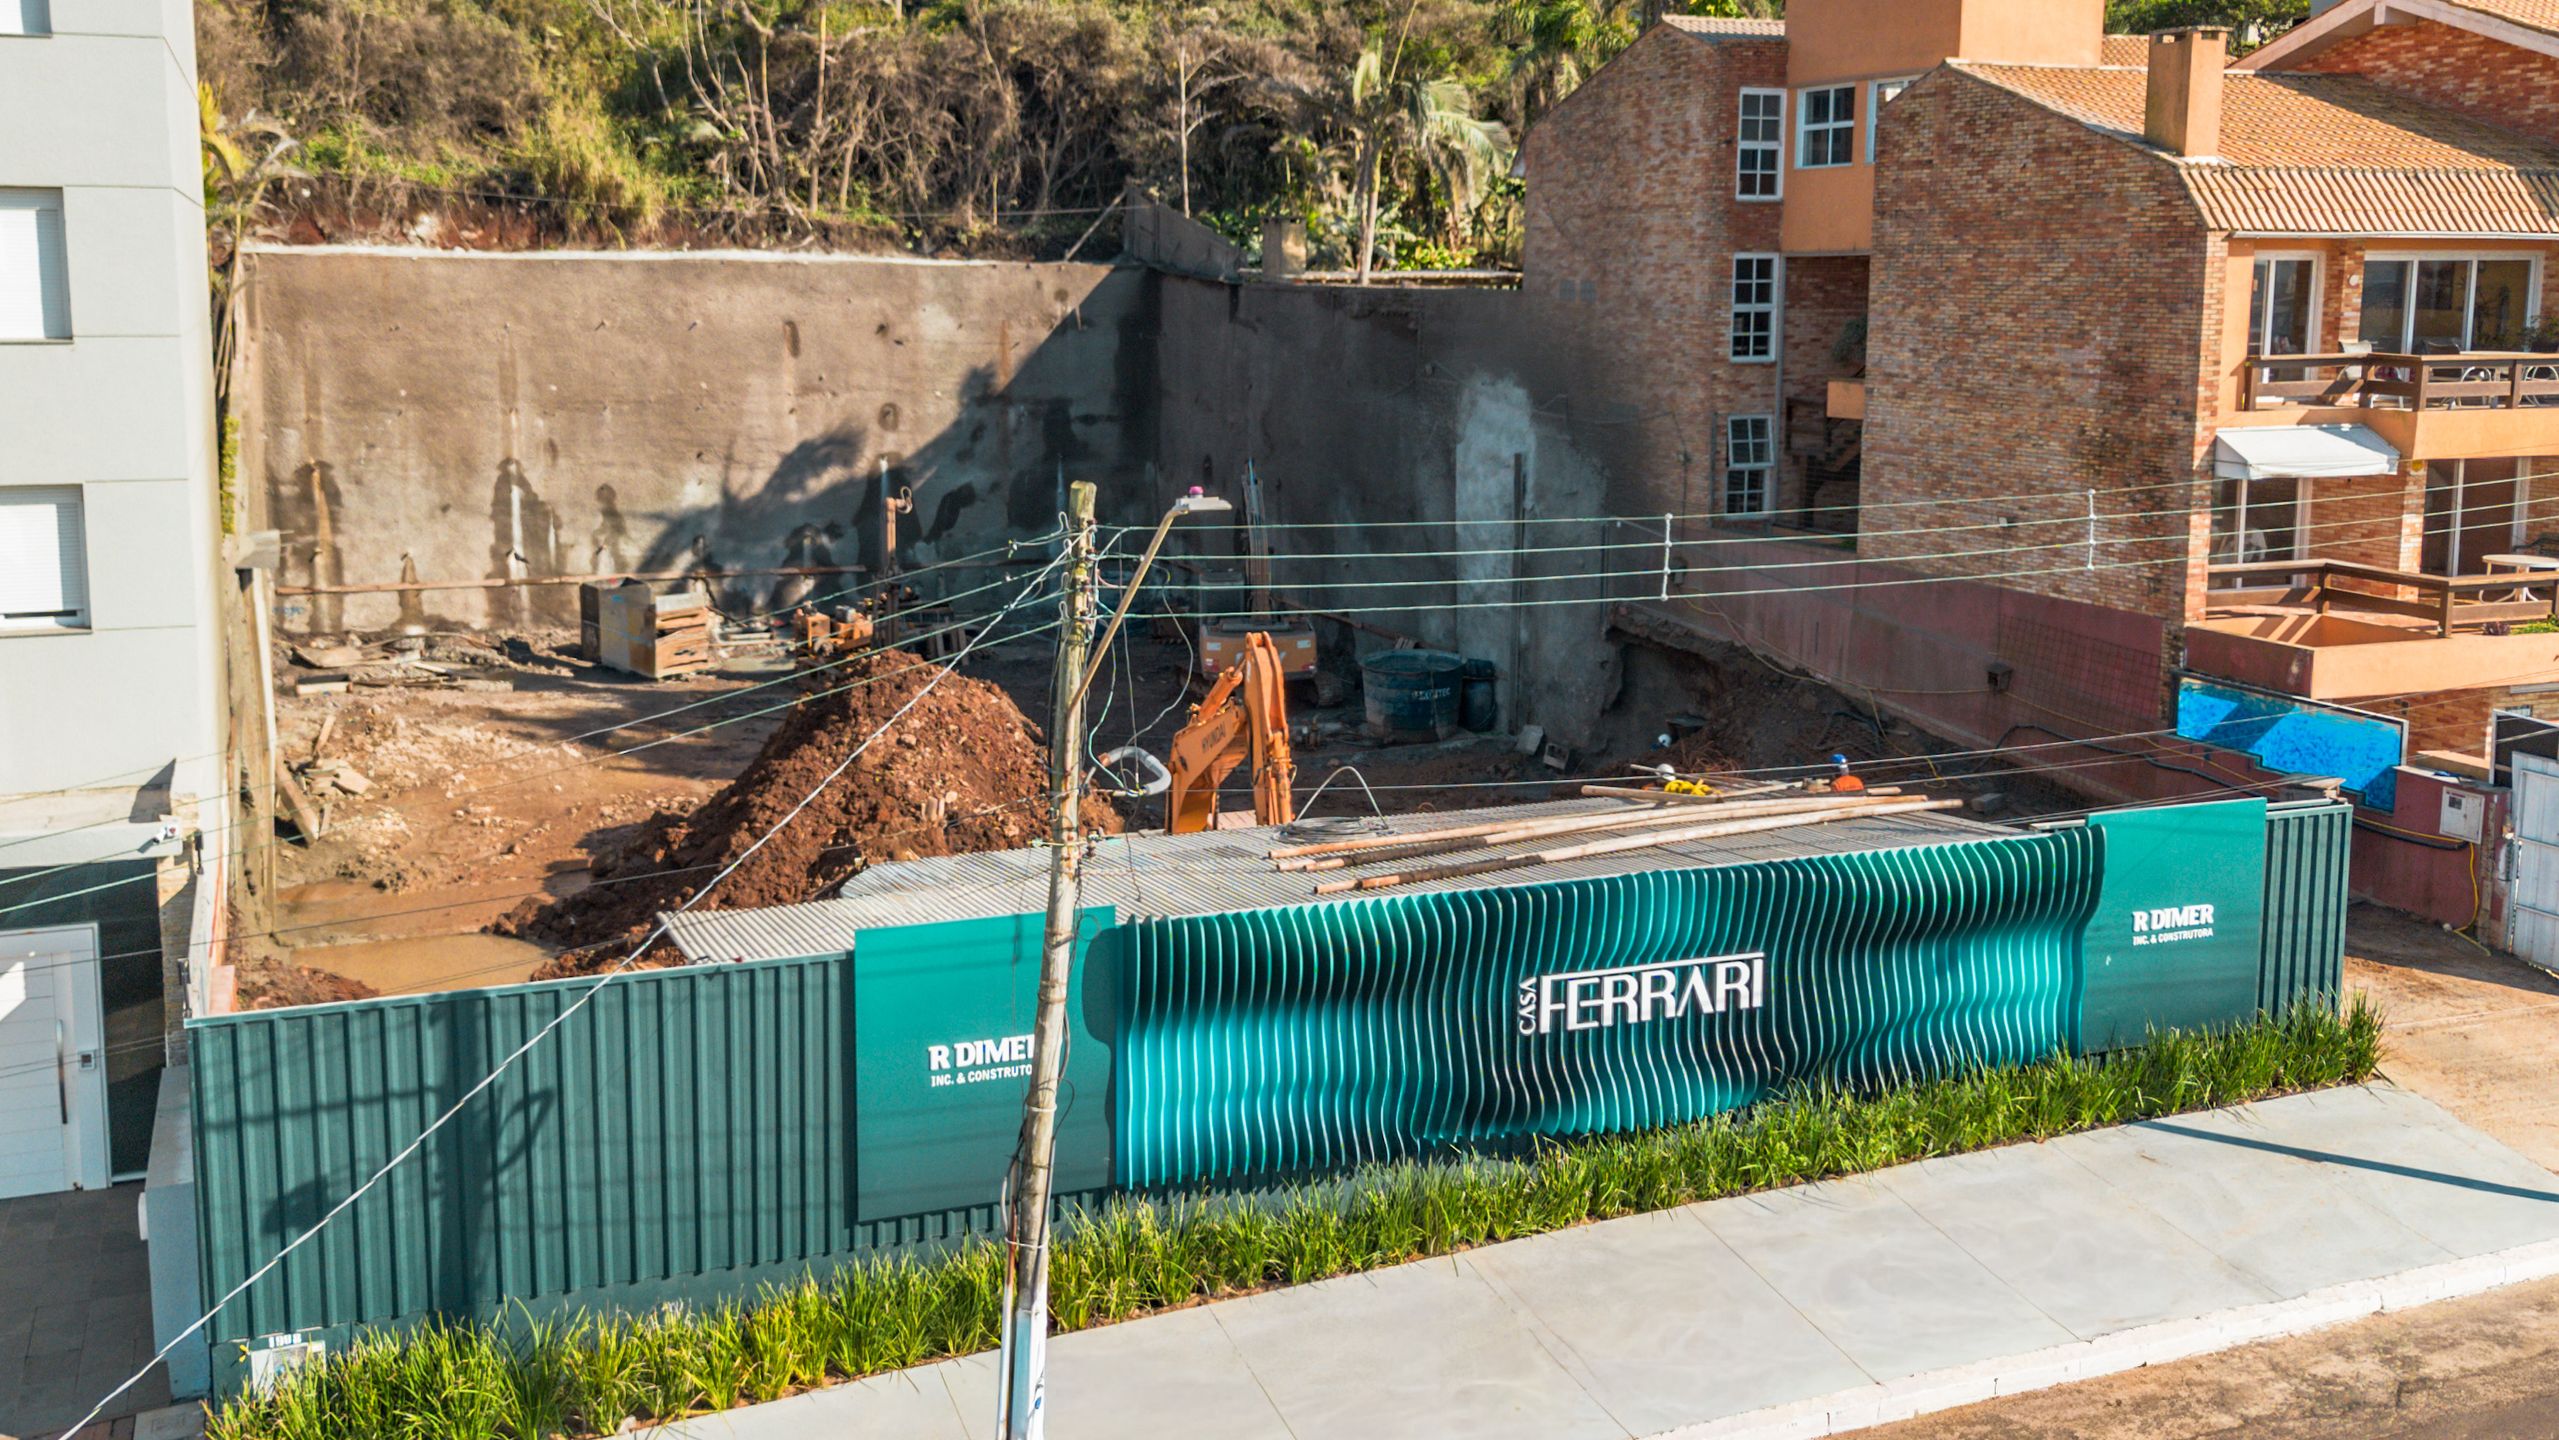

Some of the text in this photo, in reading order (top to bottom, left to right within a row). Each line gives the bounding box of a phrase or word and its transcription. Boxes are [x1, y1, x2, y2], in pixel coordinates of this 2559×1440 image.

[2132, 903, 2215, 932] R DIMER
[2132, 927, 2214, 946] INC. & CONSTRUTORA
[1518, 976, 1538, 1036] CASA
[1539, 952, 1765, 1034] FERRARI
[928, 1045, 951, 1071] R
[931, 1063, 1032, 1087] INC. & CONSTRUTO
